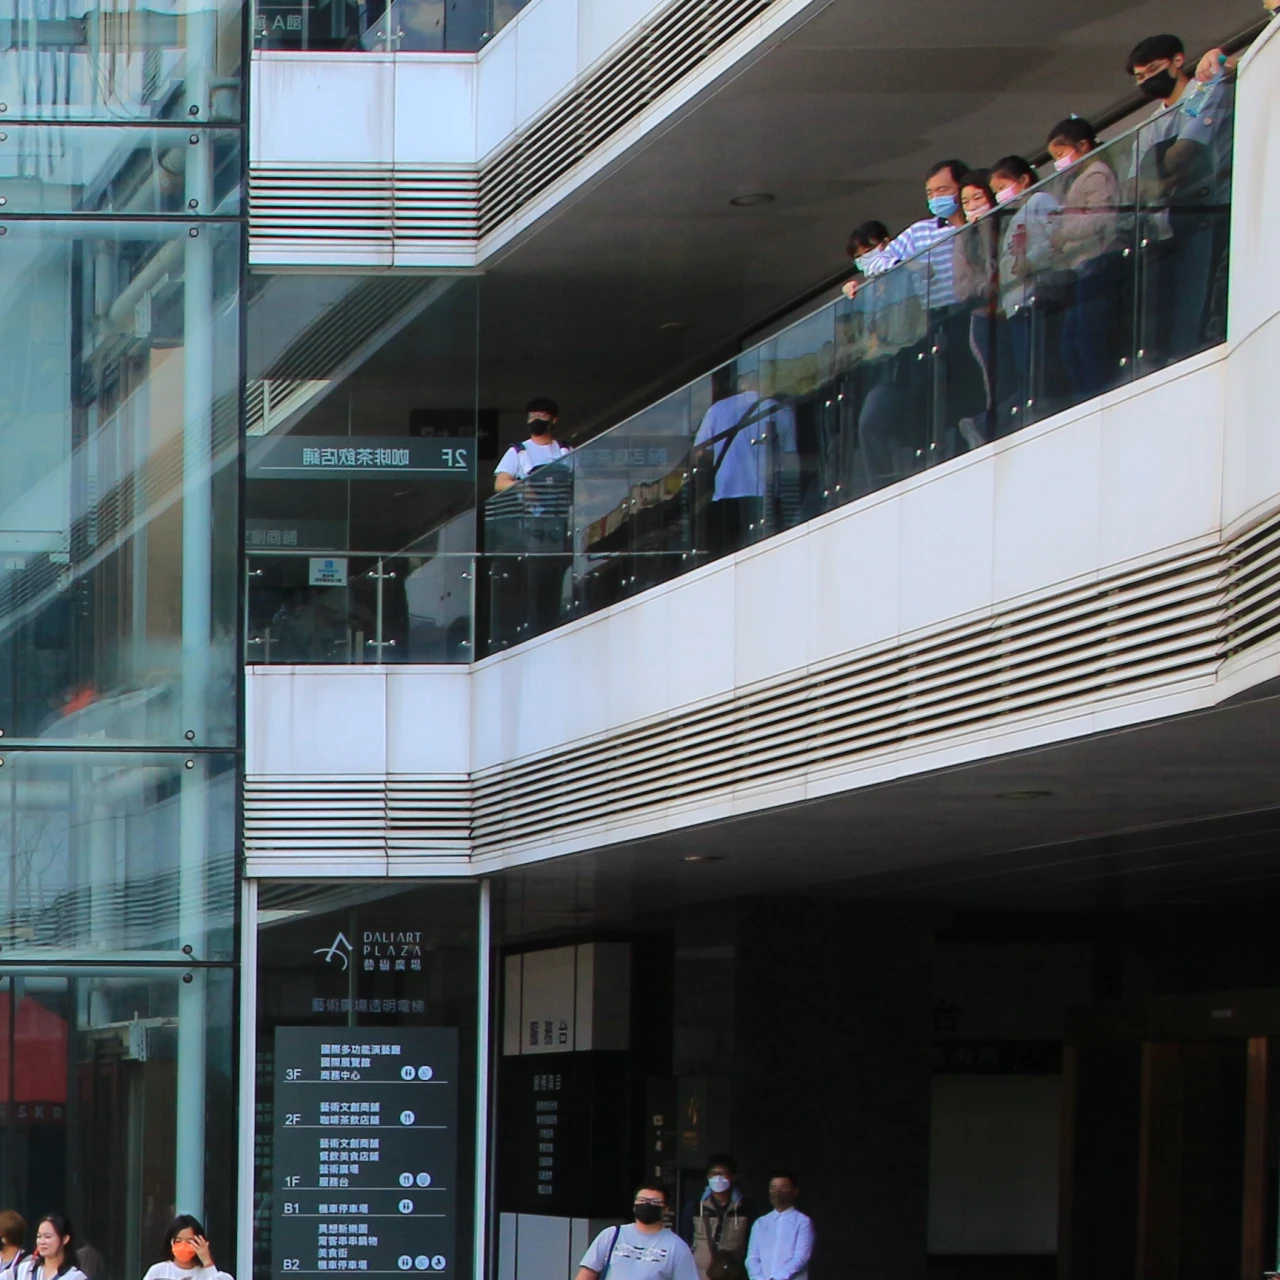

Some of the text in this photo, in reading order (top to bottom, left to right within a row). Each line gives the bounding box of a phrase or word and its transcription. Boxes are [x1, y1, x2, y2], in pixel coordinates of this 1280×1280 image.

[363, 945, 422, 957] PLAZA
[285, 1069, 302, 1080] 3F
[285, 1114, 302, 1126] 2F
[285, 1176, 301, 1187] 1F
[319, 1177, 349, 1187] 服務台
[284, 1203, 300, 1214] B1
[283, 1259, 300, 1270] B2
